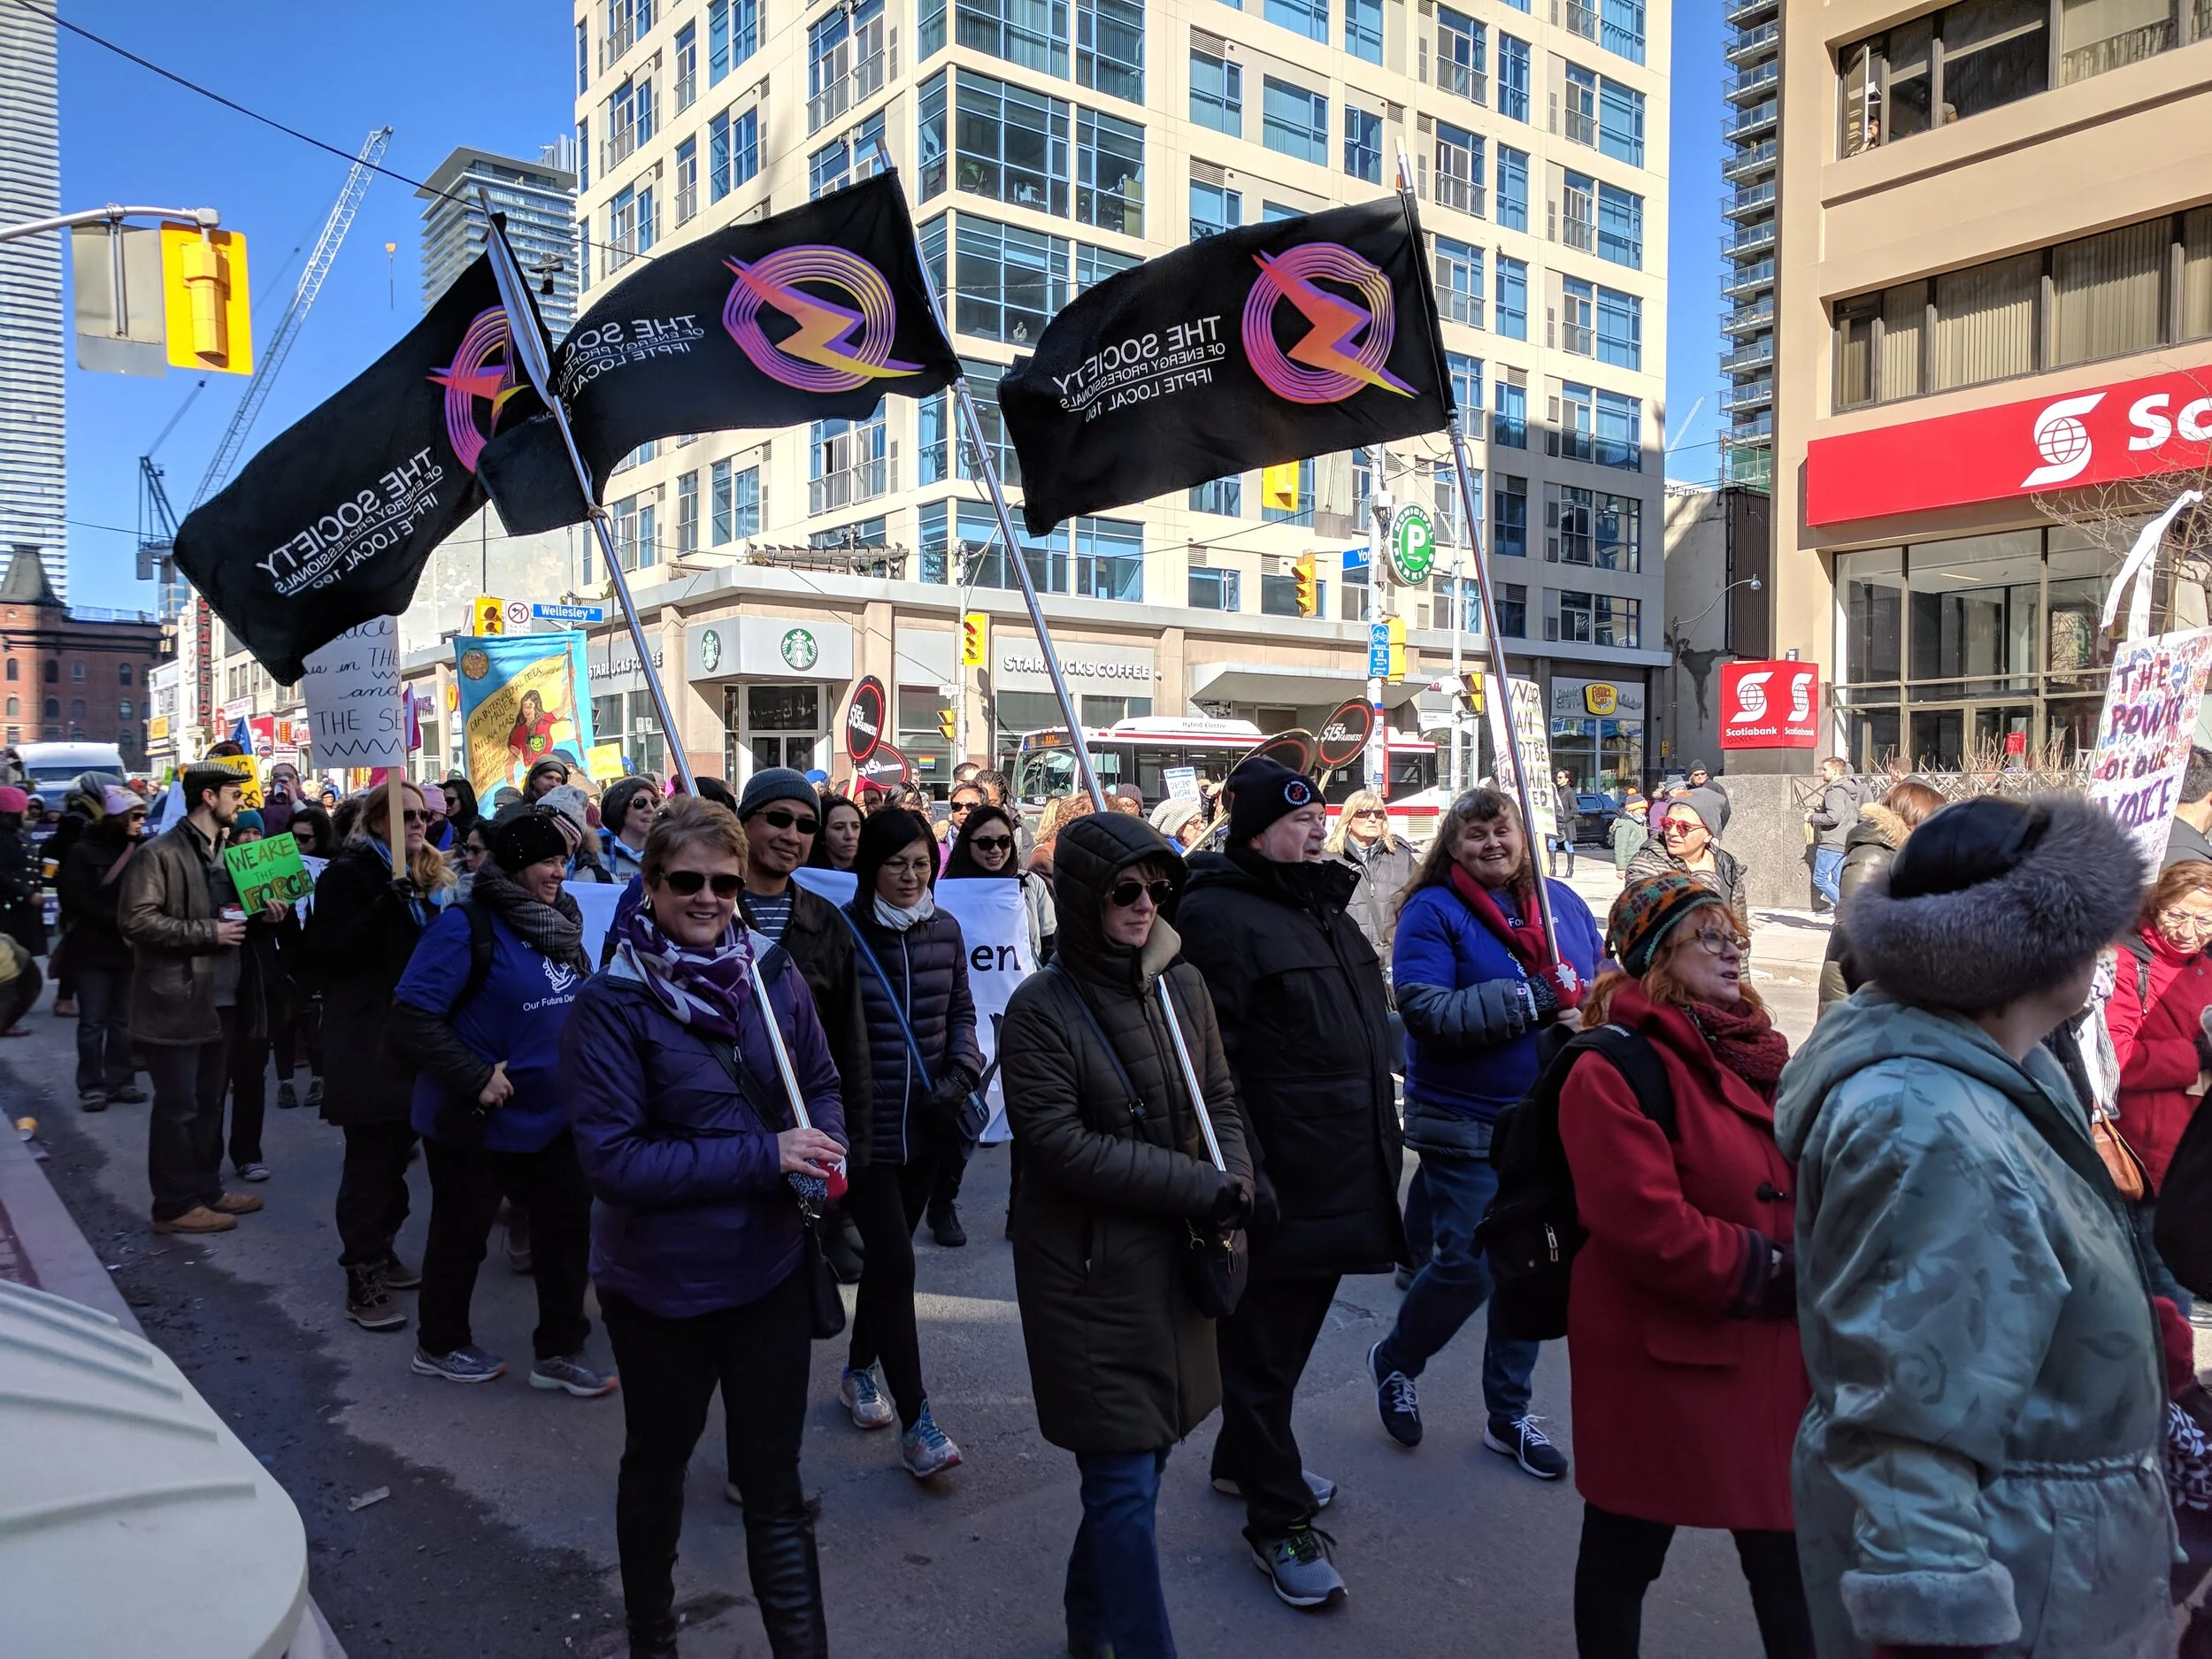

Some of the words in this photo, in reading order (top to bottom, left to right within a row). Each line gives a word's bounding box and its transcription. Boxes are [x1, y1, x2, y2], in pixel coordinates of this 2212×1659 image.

[1394, 507, 1433, 540] MUNICIPAL
[1408, 524, 1426, 555] P
[1394, 546, 1433, 580] PARKING
[541, 604, 588, 619] Wellesley
[197, 597, 211, 726] Seduction
[1003, 656, 1094, 677] STARUCKS
[1095, 664, 1149, 680] COFFEE
[2116, 659, 2170, 694] THE
[314, 709, 362, 736] THE
[1725, 726, 1778, 737] Scotiabank
[1785, 726, 1815, 736] Scotiabank
[2110, 694, 2185, 740] POWER
[1320, 725, 1342, 743] $15
[2105, 758, 2130, 781] OF
[2132, 745, 2169, 779] OUR
[2101, 776, 2174, 829] VOICE
[228, 847, 258, 872] WE
[258, 837, 295, 864] ARE
[243, 870, 315, 913] FORCE
[253, 868, 276, 883] THE
[523, 1001, 540, 1011] Our
[541, 997, 563, 1007] Future
